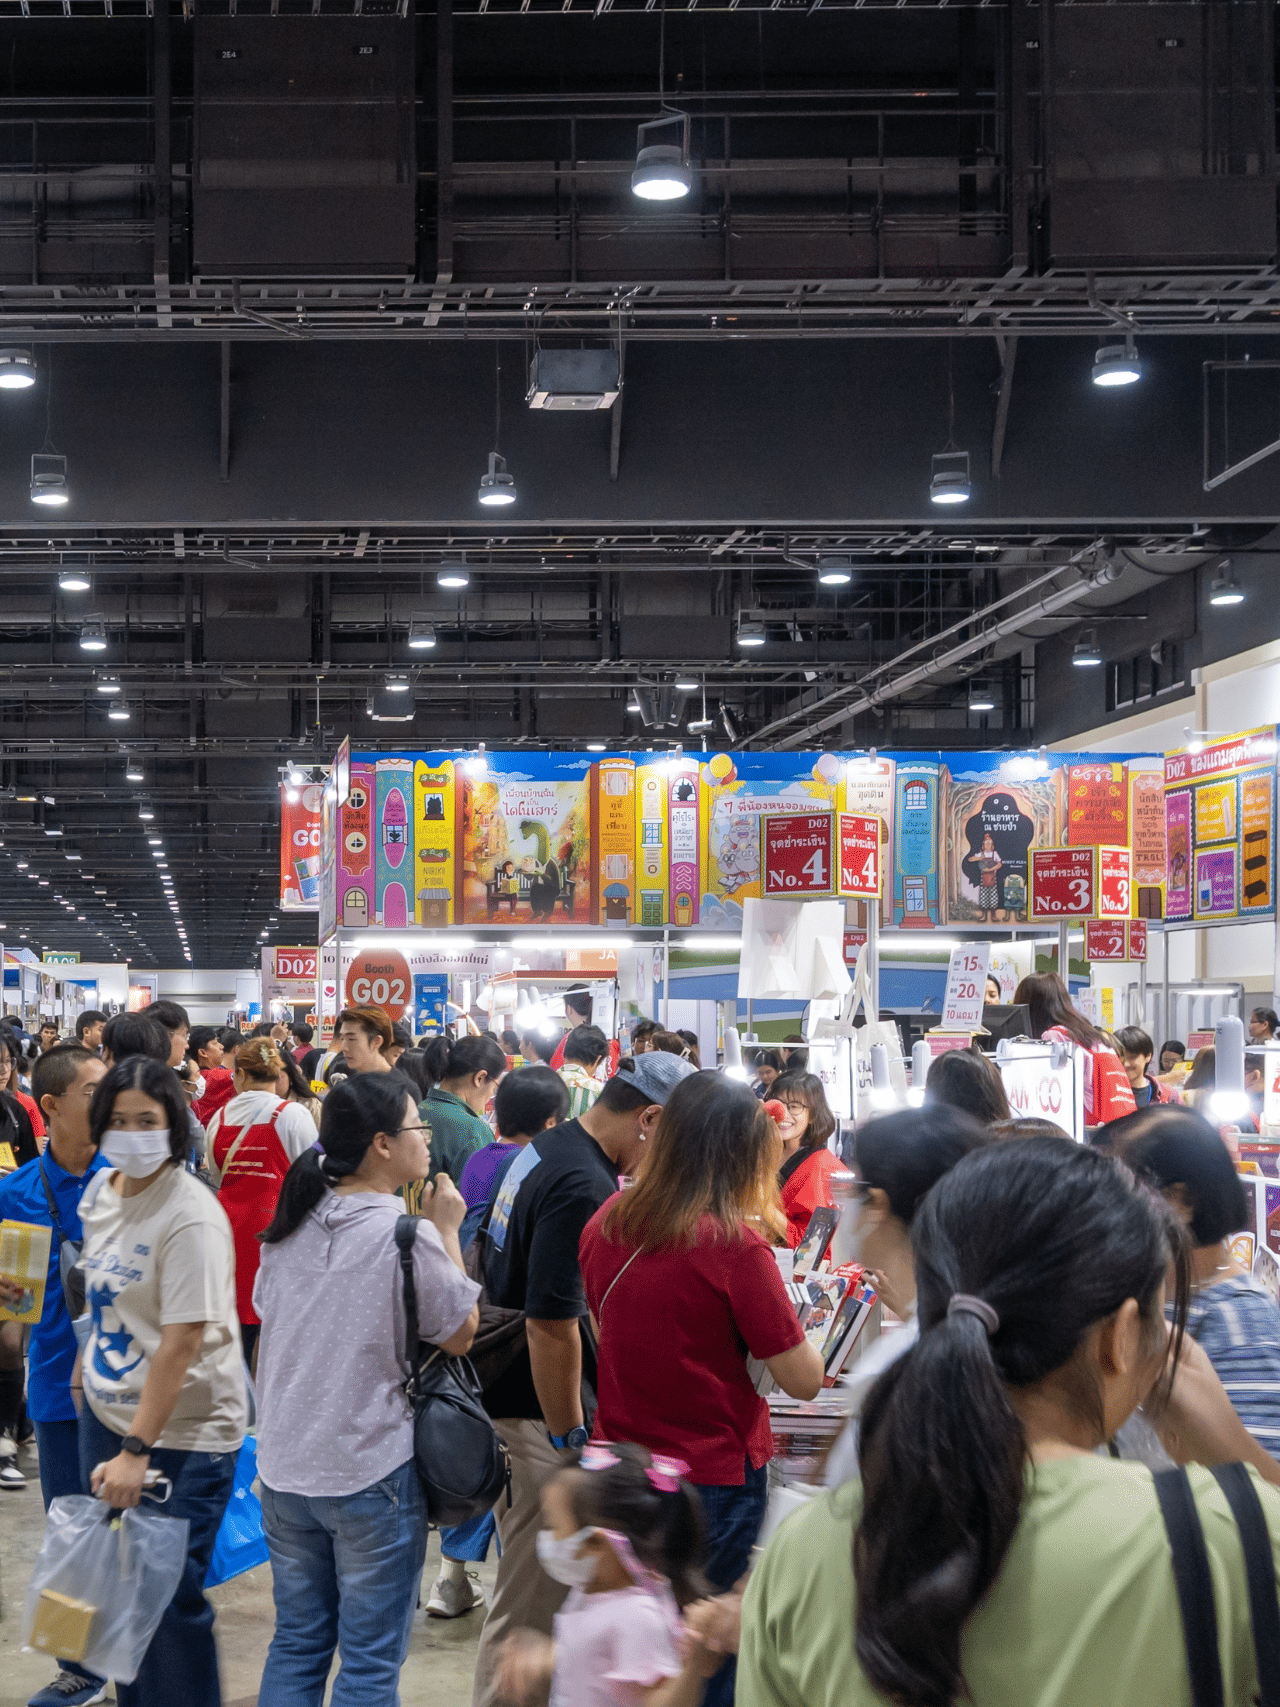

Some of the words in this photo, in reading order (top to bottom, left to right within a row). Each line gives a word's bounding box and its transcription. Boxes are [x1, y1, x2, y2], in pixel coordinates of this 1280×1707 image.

[1166, 761, 1186, 780] D02
[502, 801, 558, 816] ไดโนเสาร์
[724, 801, 732, 813] 7
[808, 818, 828, 829] D02
[292, 829, 321, 847] G0
[769, 834, 827, 853] จุดชำระเงิน
[1071, 853, 1090, 862] D02
[1036, 866, 1089, 881] จุดชำระเงิน
[277, 958, 316, 975] D02
[364, 963, 394, 974] Booth
[351, 977, 406, 1005] G02
